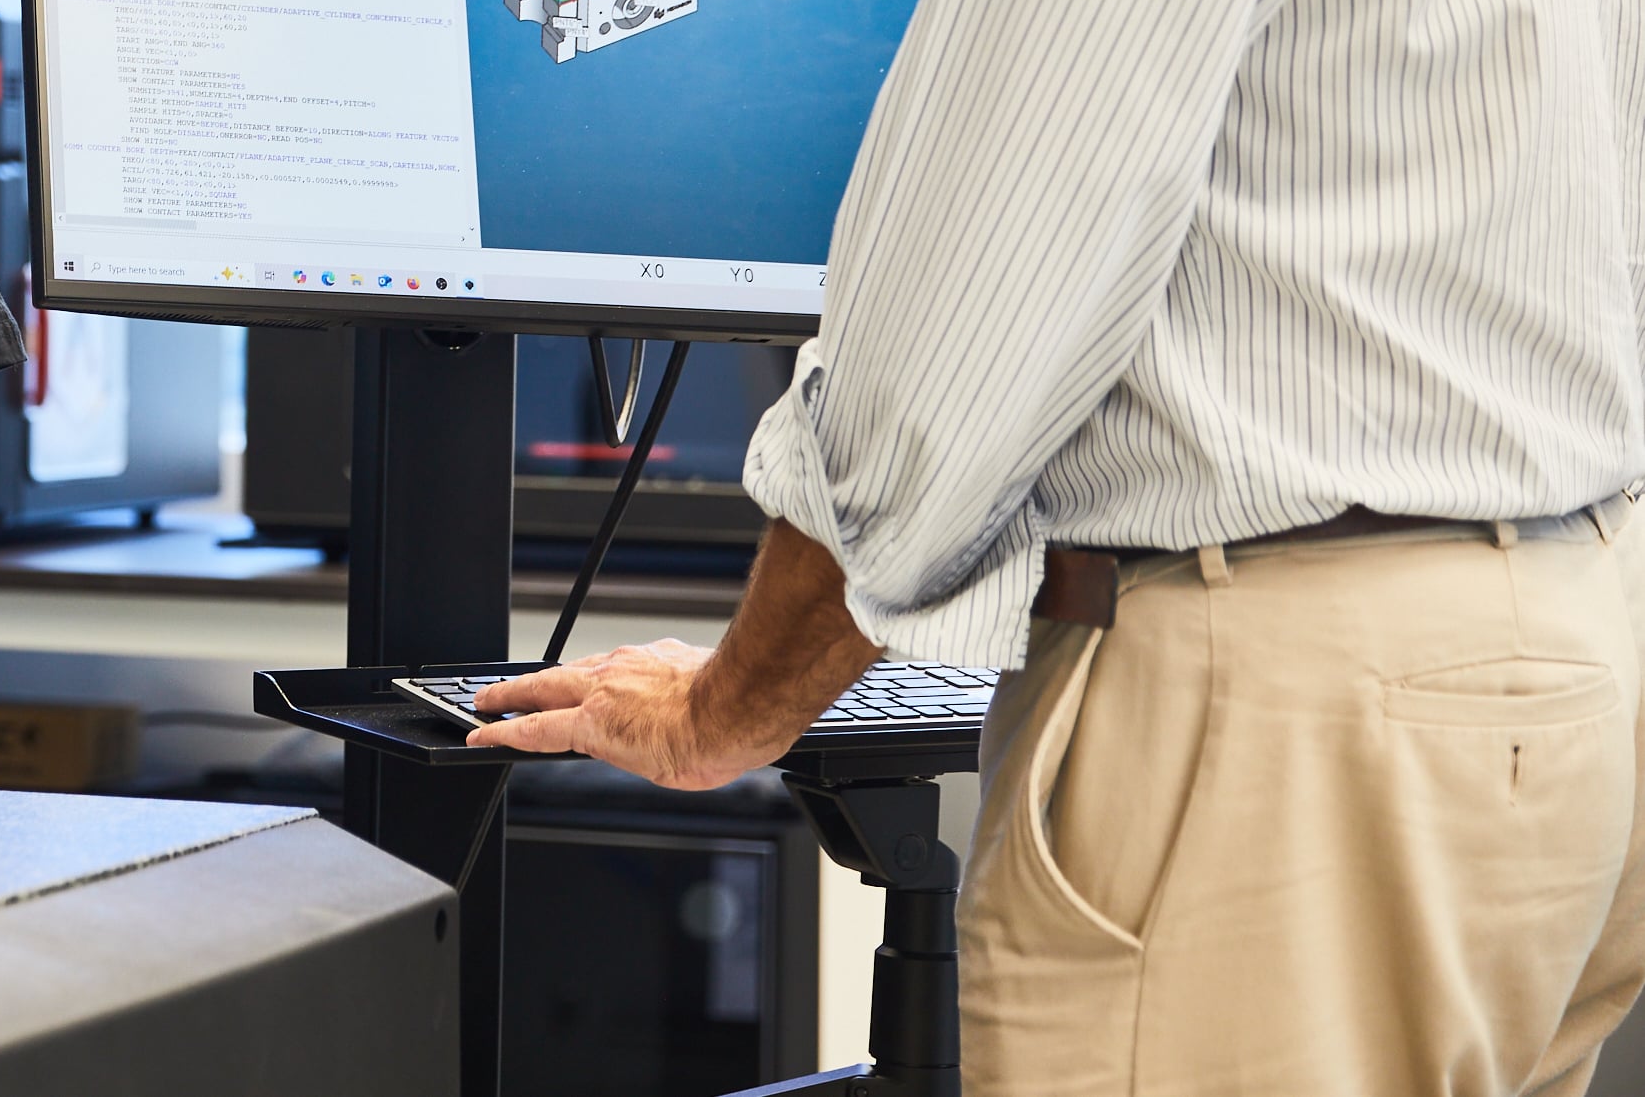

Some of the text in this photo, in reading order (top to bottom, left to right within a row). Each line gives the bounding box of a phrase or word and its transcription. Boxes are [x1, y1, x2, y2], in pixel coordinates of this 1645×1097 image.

[108, 264, 185, 276] Type here to search
